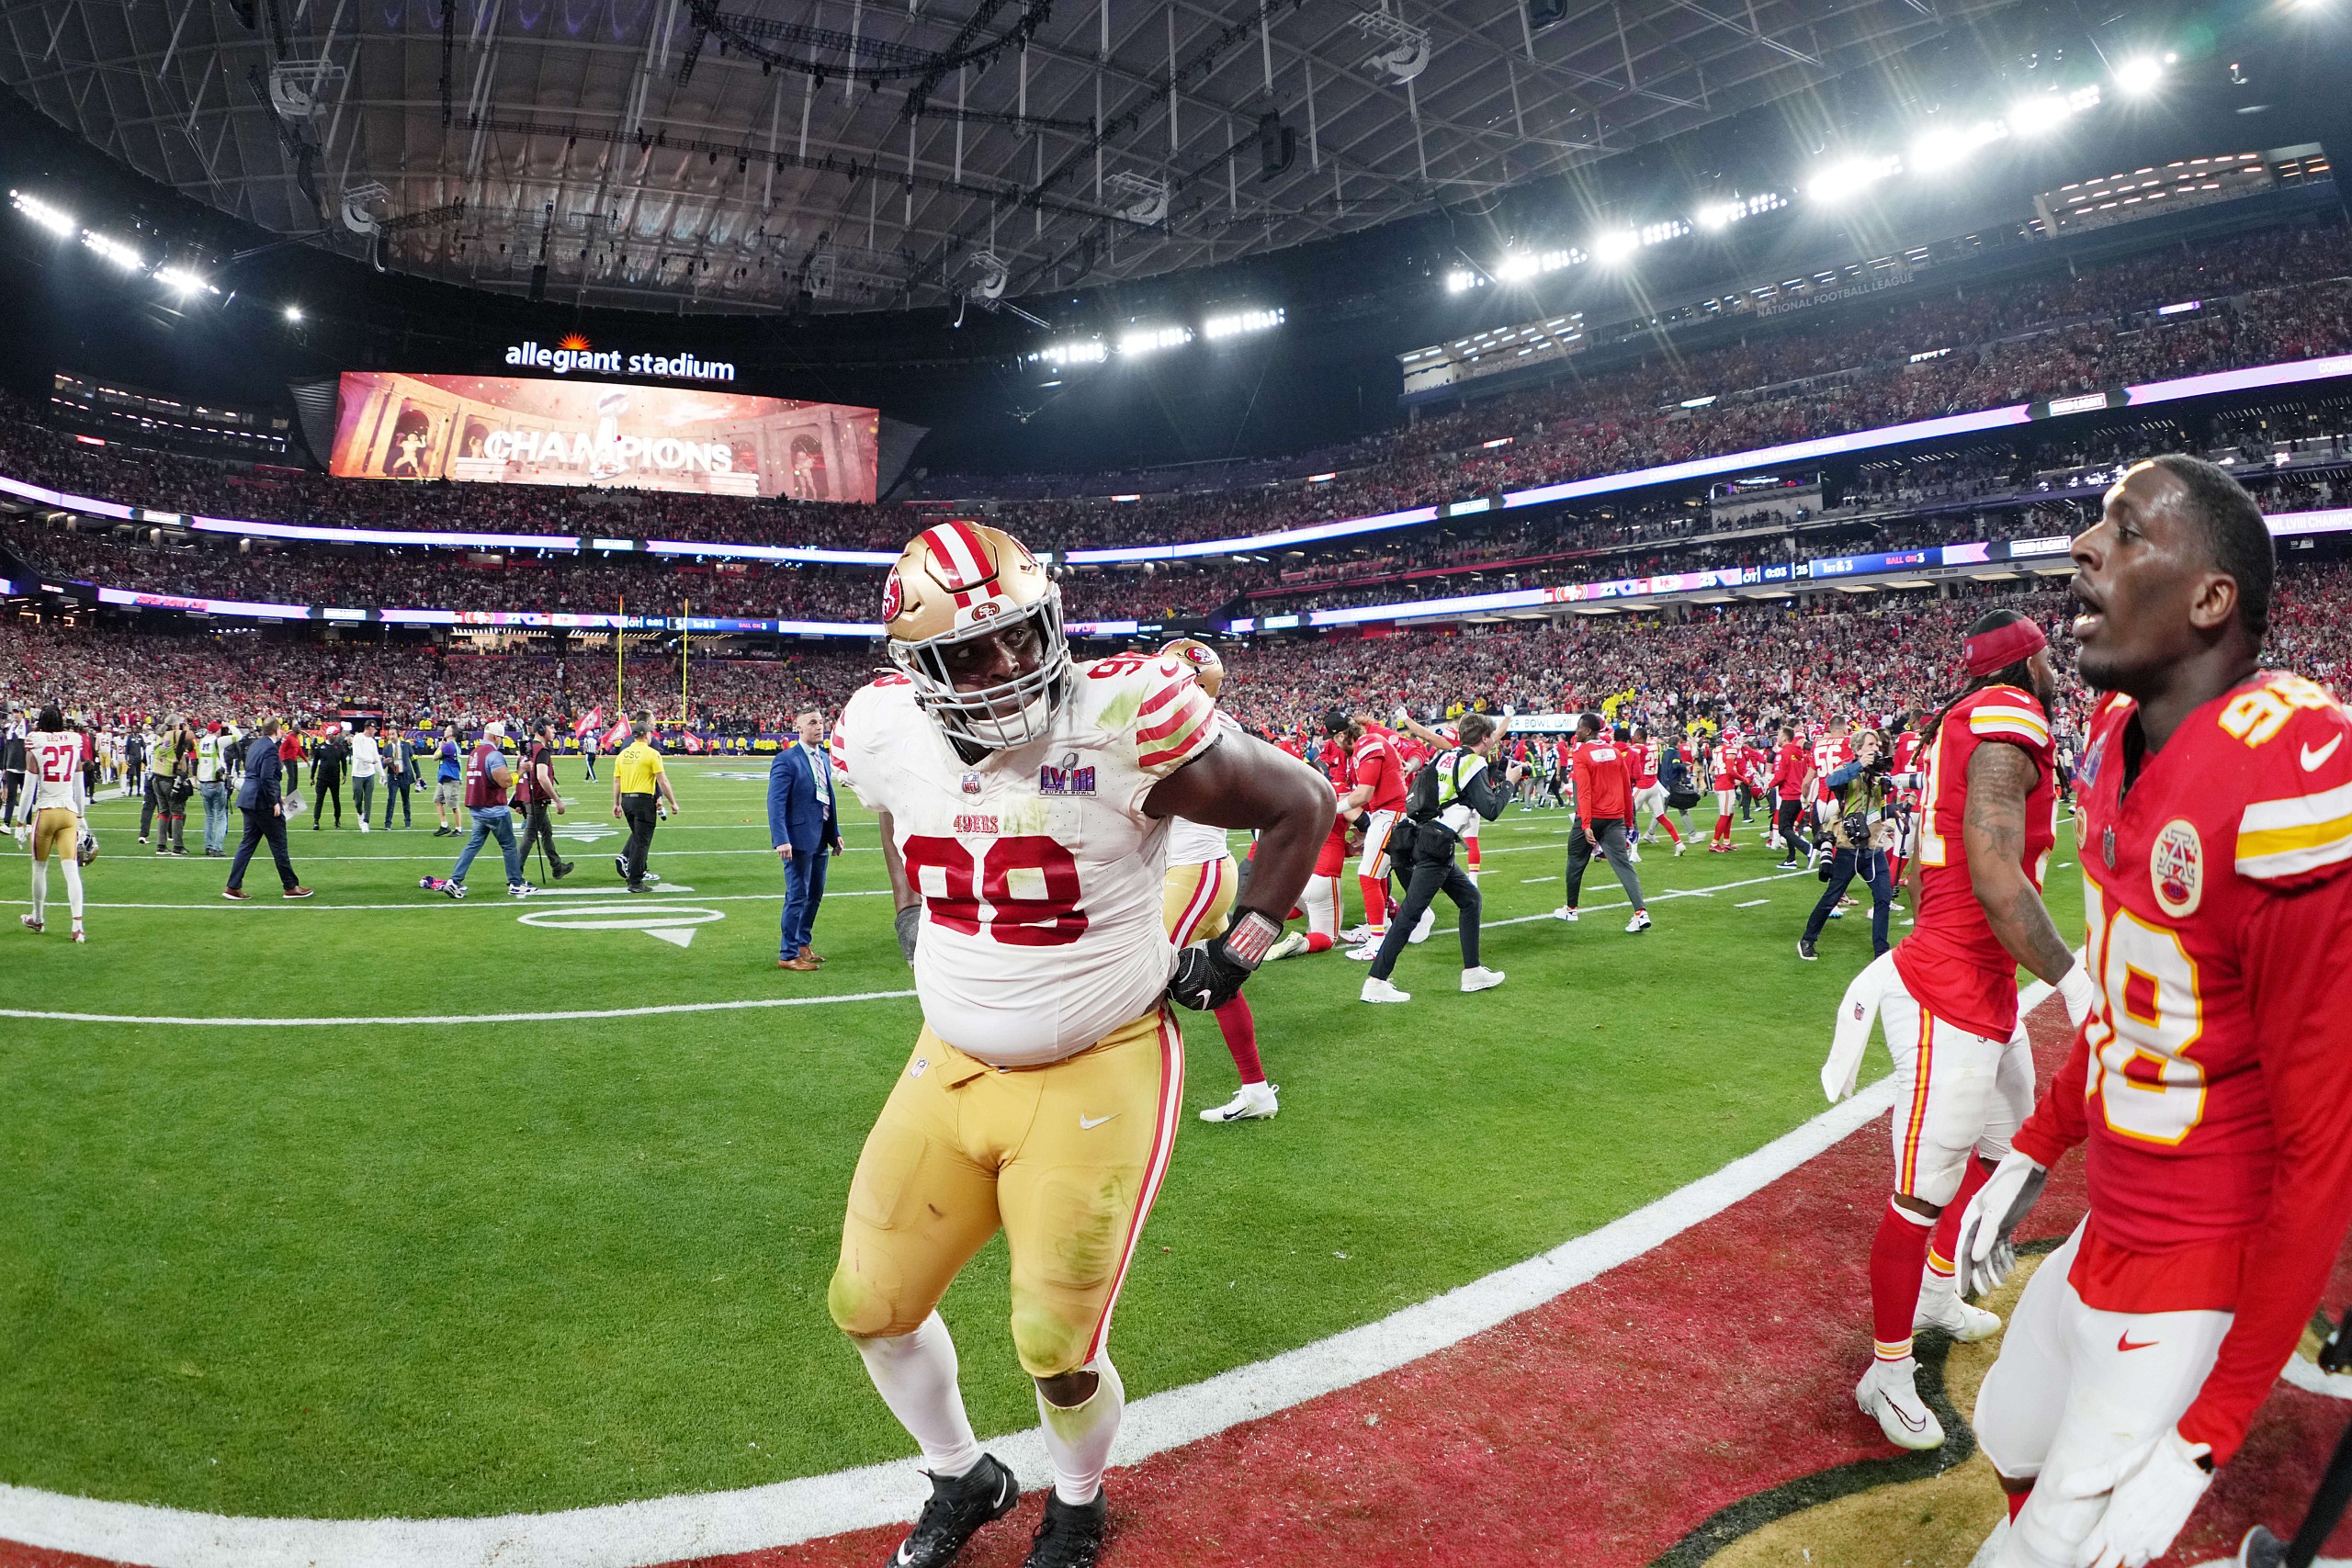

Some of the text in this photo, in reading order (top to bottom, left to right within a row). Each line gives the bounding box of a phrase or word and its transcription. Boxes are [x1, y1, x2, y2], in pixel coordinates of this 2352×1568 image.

[1757, 273, 1915, 319] NATIONAL FOOTBALL LEAGUE
[505, 341, 735, 381] allegiant stadium
[483, 430, 733, 473] CHAMPIONS
[1719, 457, 1743, 470] BOWL
[1762, 444, 1815, 461] CHAMPIONS
[1815, 438, 1847, 453] CHIEFS
[2286, 516, 2307, 530] LVIII
[1600, 582, 1617, 597] 22
[1699, 574, 1717, 588] 25
[1743, 572, 1757, 583] OT
[1765, 566, 1787, 579] 0:03
[1795, 564, 1809, 576] 25
[1885, 556, 1904, 565] BALL
[1917, 552, 1925, 563] 3
[1524, 718, 1551, 728] BOWL
[2218, 677, 2341, 749] 98
[42, 745, 74, 782] 27
[623, 750, 641, 759] CSC
[1814, 745, 1841, 778] 56
[965, 782, 979, 792] NFL
[1041, 764, 1095, 791] LVIII
[953, 814, 999, 834] 49ERS
[902, 834, 1089, 947] 98
